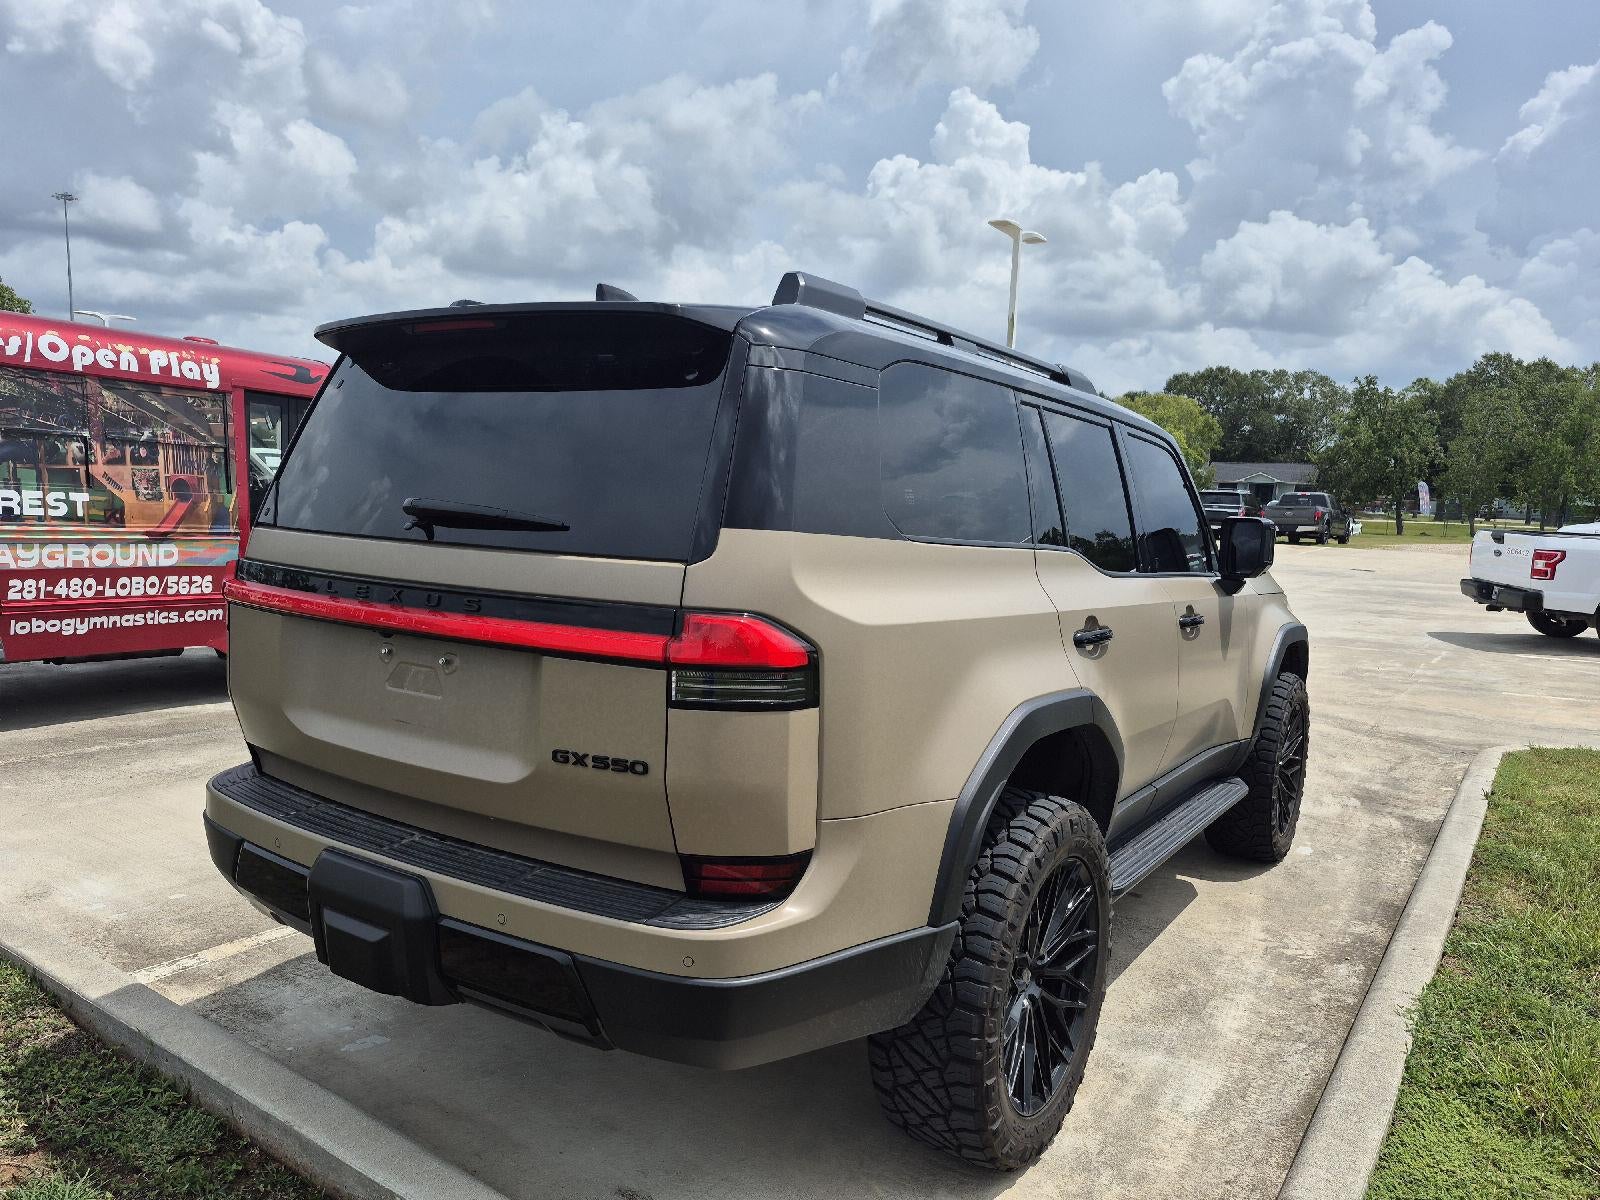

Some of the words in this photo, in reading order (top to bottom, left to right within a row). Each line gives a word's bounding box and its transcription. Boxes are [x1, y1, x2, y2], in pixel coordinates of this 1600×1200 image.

[148, 349, 220, 389] Play
[0, 489, 90, 517] REST
[7, 575, 213, 600] 281-480-LOBO/5626
[327, 580, 482, 613] LEXUS
[9, 608, 224, 636] lobogymnastics.com
